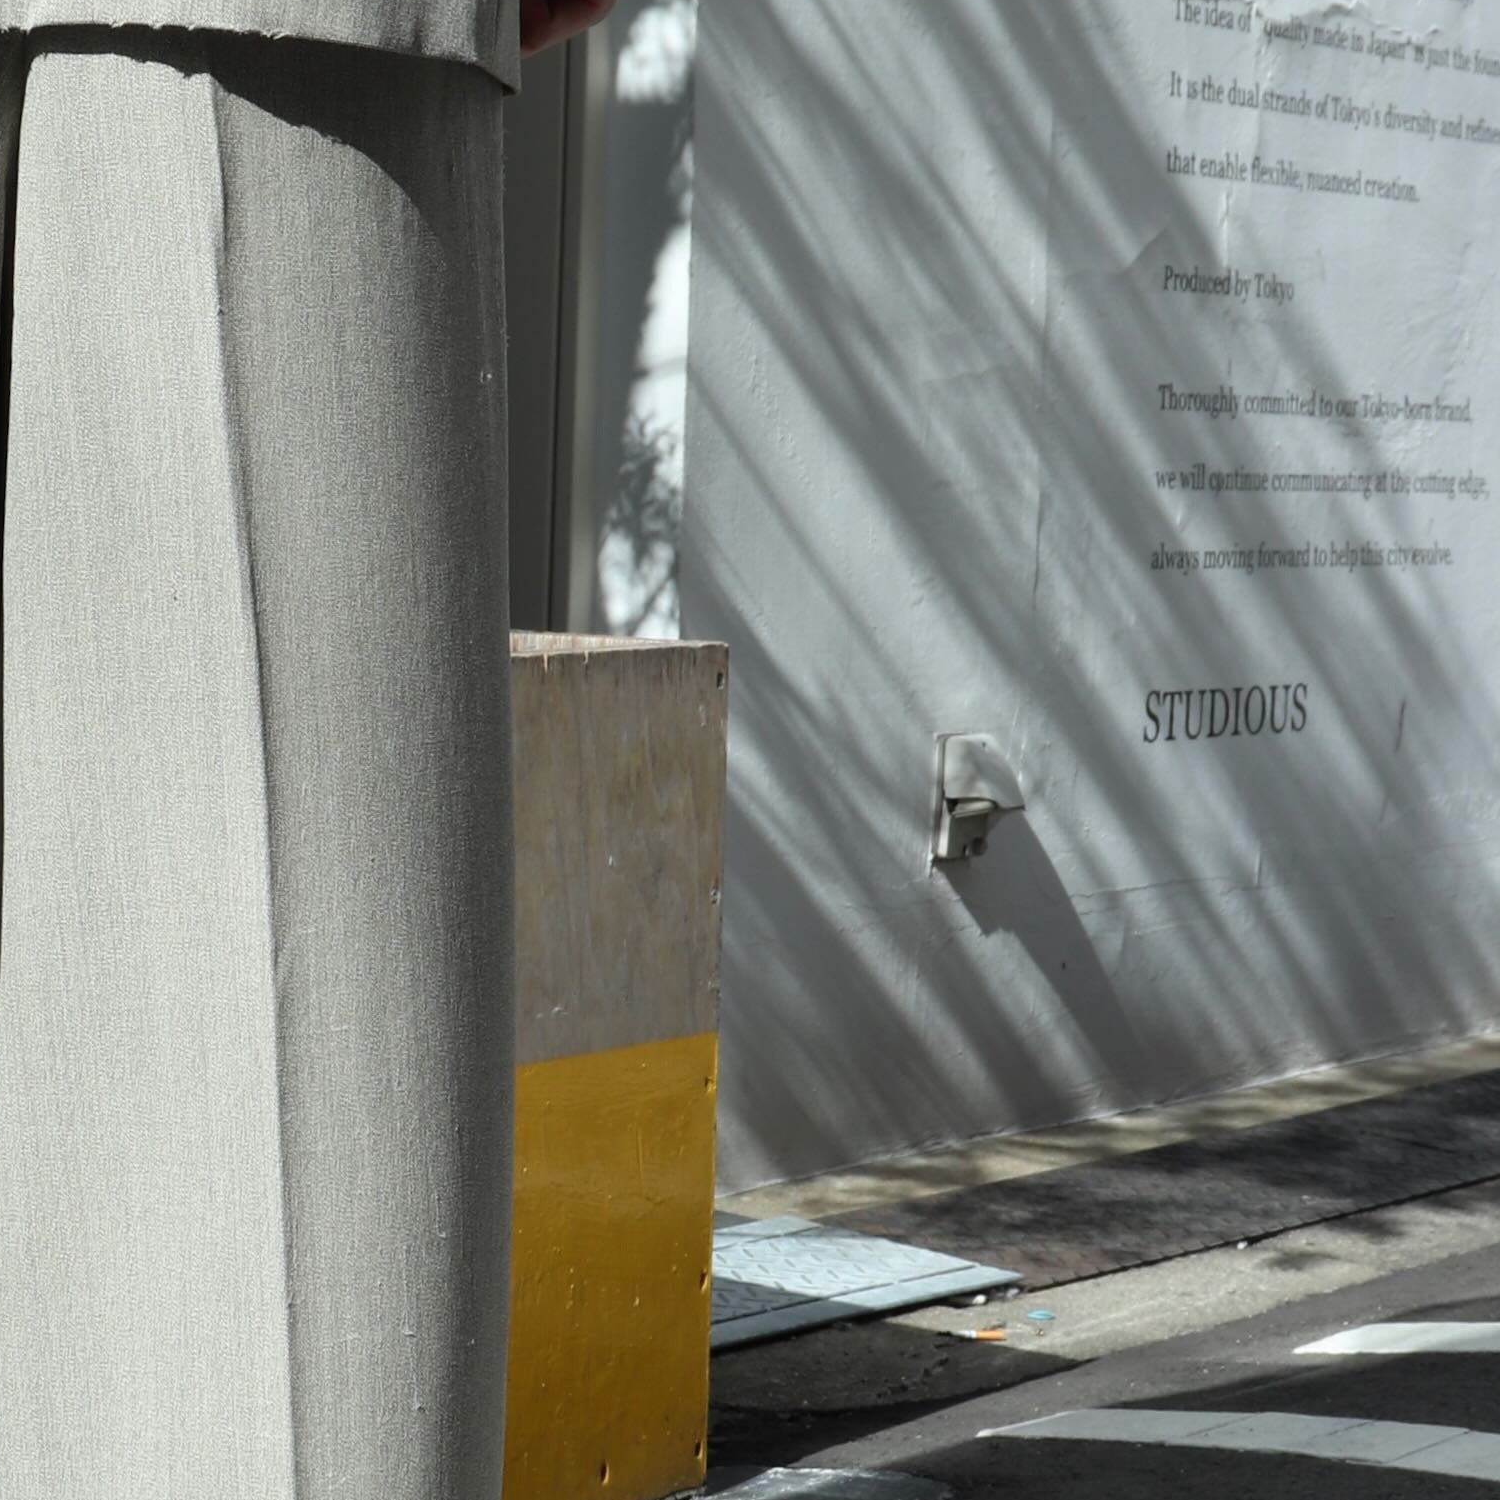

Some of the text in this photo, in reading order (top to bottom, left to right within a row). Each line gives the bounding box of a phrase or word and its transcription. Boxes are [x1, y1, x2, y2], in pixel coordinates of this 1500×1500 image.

[1236, 0, 1253, 34] of
[1312, 22, 1349, 51] made
[1350, 26, 1365, 53] in
[1424, 39, 1450, 72] just
[1451, 44, 1472, 73] the
[1168, 69, 1183, 99] It
[1185, 77, 1199, 101] is
[1200, 74, 1225, 105] the
[1226, 75, 1260, 108] dual
[1261, 88, 1312, 117] strands
[1314, 92, 1331, 120] of
[1382, 102, 1437, 141] diversity
[1439, 114, 1463, 140] and
[1165, 145, 1197, 176] that
[1199, 151, 1247, 181] enable
[1306, 169, 1362, 196] nuanced
[1164, 264, 1295, 307] Produced by Tokyo
[1157, 383, 1239, 420] Thoroughly
[1243, 388, 1317, 417] committed
[1318, 393, 1334, 418] to
[1334, 398, 1359, 418] our
[1361, 392, 1432, 425] Tokyo-born
[1155, 470, 1178, 491] we
[1178, 462, 1207, 491] will
[1208, 465, 1269, 493] continue
[1270, 467, 1373, 501] communicating
[1374, 470, 1388, 493] at
[1390, 467, 1411, 496] the
[1412, 468, 1456, 501] cutting
[1149, 541, 1200, 576] always
[1202, 541, 1254, 575] moving
[1256, 540, 1311, 569] forward
[1313, 545, 1329, 569] to
[1329, 539, 1359, 573] help
[1359, 540, 1385, 567] this
[1386, 539, 1411, 571] city
[1143, 682, 1308, 743] STUDIOUS
